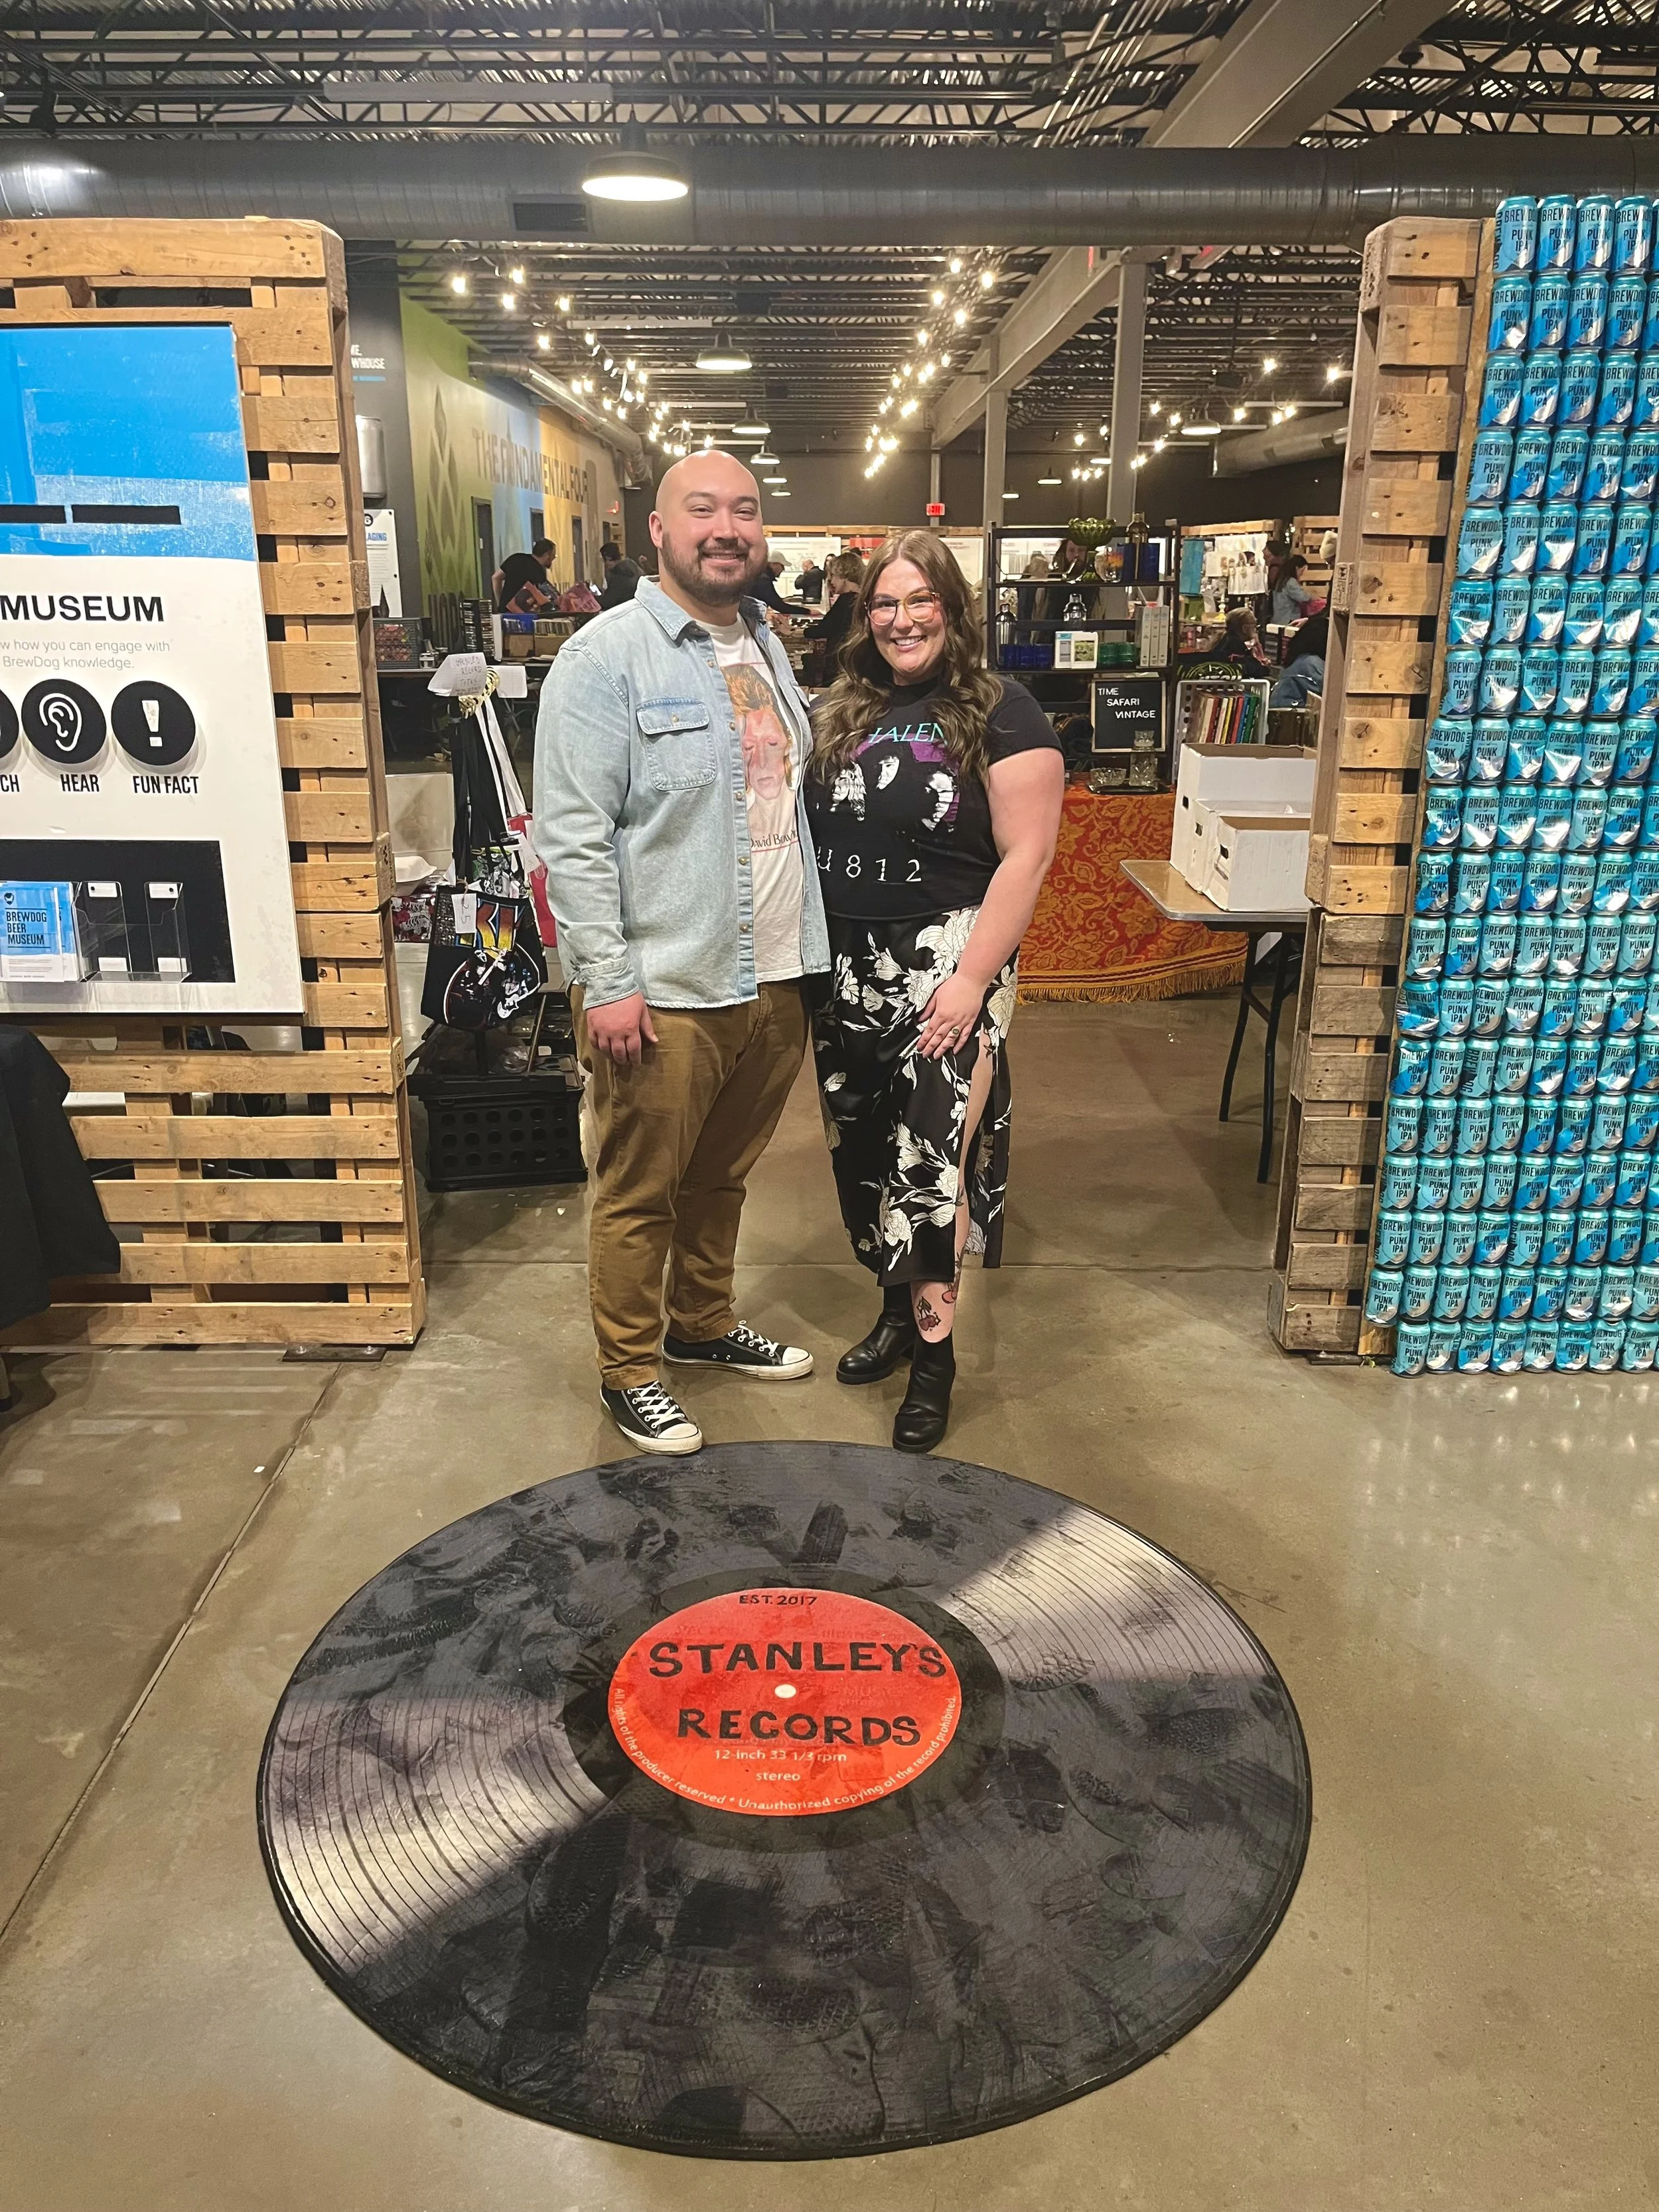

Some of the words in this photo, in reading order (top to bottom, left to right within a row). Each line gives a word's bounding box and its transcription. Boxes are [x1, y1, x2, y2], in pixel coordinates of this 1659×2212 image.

[1500, 309, 1523, 321] PUNK
[1542, 308, 1563, 319] PUNK
[1577, 308, 1599, 319] PUNK
[1616, 309, 1638, 320] PUNK
[1546, 319, 1558, 330] IPA
[1580, 318, 1593, 329] IPA
[1619, 321, 1632, 332] IPA
[1493, 388, 1515, 398] PUNK
[1568, 386, 1590, 396] PUNK
[1484, 463, 1505, 473] PUNK
[1632, 464, 1654, 474] PUNK
[1486, 473, 1499, 483] IPA
[1470, 538, 1492, 548] PUNK
[0, 595, 165, 622] MUSEUM
[1503, 609, 1522, 618] PUNK
[14, 639, 40, 650] how
[44, 641, 66, 653] you
[69, 641, 92, 651] can
[95, 641, 142, 654] engage
[145, 640, 170, 652] with
[3, 656, 60, 670] BrewDog
[64, 657, 135, 670] knowledge.
[1532, 677, 1552, 686] PUNK
[1115, 710, 1156, 719] VINTAGE
[1430, 729, 1465, 742] BREWDOG
[1435, 747, 1455, 757] PUNK
[1477, 747, 1497, 757] PUNK
[1589, 751, 1610, 761] PUNK
[1628, 756, 1640, 767] IPA
[60, 774, 100, 792] HEAR
[133, 776, 161, 794] FUN
[164, 776, 199, 794] FACT
[1474, 814, 1496, 822] PUNK
[1617, 814, 1637, 824] PUNK
[1496, 878, 1517, 888] PUNK
[1568, 881, 1589, 890] PUNK
[1470, 889, 1481, 898] IPA
[1570, 891, 1582, 899] IPA
[6, 911, 47, 922] BREWDOG
[7, 922, 27, 933] BEER
[8, 934, 44, 944] MUSEUM
[1412, 929, 1444, 940] BREWDOG
[1415, 944, 1434, 953] PUNK
[1457, 944, 1477, 952] PUNK
[1489, 940, 1510, 950] PUNK
[1530, 941, 1550, 950] PUNK
[1554, 943, 1574, 952] PUNK
[1597, 942, 1617, 950] PUNK
[1630, 940, 1650, 949] PUNK
[1419, 953, 1429, 962] IPA
[1493, 950, 1505, 959] IPA
[1600, 950, 1611, 960] IPA
[1633, 949, 1645, 958] IPA
[1448, 1005, 1468, 1014] PUNK
[1475, 1004, 1495, 1015] PUNK
[1513, 1001, 1534, 1011] PUNK
[1552, 1005, 1572, 1013] PUNK
[1578, 1003, 1597, 1012] PUNK
[1620, 1001, 1639, 1010] PUNK
[1451, 1013, 1463, 1023] IPA
[1478, 1014, 1490, 1023] IPA
[1555, 1013, 1567, 1023] IPA
[1581, 1011, 1593, 1021] IPA
[1440, 1066, 1459, 1074] PUNK
[1506, 1062, 1524, 1071] PUNK
[1575, 1066, 1595, 1074] PUNK
[1443, 1074, 1454, 1083] IPA
[1508, 1070, 1520, 1080] IPA
[1502, 1122, 1520, 1131] PUNK
[1603, 1120, 1622, 1128] PUNK
[1636, 1117, 1653, 1126] PUNK
[1398, 1122, 1416, 1132] PUNK
[1469, 1124, 1487, 1134] PUNK
[1639, 1126, 1649, 1135] IPA
[1401, 1132, 1412, 1140] IPA
[1473, 1133, 1483, 1142] IPA
[1506, 1130, 1515, 1138] IPA
[1606, 1128, 1616, 1137] IPA
[1429, 1180, 1449, 1189] PUNK
[1494, 1178, 1513, 1187] PUNK
[1527, 1181, 1545, 1190] PUNK
[1397, 1189, 1407, 1198] IPA
[1463, 1189, 1474, 1198] IPA
[1498, 1187, 1509, 1196] IPA
[1560, 1187, 1571, 1197] IPA
[1390, 1236, 1407, 1244] PUNK
[1418, 1236, 1435, 1244] PUNK
[1587, 1234, 1606, 1242] PUNK
[1393, 1244, 1404, 1253] IPA
[1421, 1244, 1432, 1253] IPA
[1456, 1244, 1466, 1253] IPA
[1590, 1242, 1601, 1250] IPA
[1370, 1279, 1400, 1292] BREWDOG
[1407, 1290, 1426, 1299] PUNK
[1445, 1290, 1462, 1299] PUNK
[1569, 1290, 1587, 1298] PUNK
[1374, 1294, 1394, 1305] PUNK
[1409, 1298, 1421, 1307] IPA
[1448, 1299, 1459, 1308] IPA
[1481, 1298, 1492, 1307] IPA
[1532, 1341, 1551, 1351] PUNK
[1596, 1342, 1615, 1351] PUNK
[1405, 1347, 1423, 1356] PUNK
[1407, 1355, 1419, 1364] IPA
[738, 1594, 772, 1605] EST.
[777, 1595, 818, 1605] 2017
[614, 1688, 625, 1700] All
[613, 1700, 626, 1726] rights
[936, 1695, 958, 1742] prohibited.
[619, 1726, 632, 1737] of
[677, 1708, 921, 1746] RECORDS
[624, 1735, 638, 1751] the
[715, 1749, 766, 1760] 12-inch
[770, 1749, 787, 1760] 33
[792, 1751, 815, 1761] 1/3
[817, 1752, 847, 1763] rpm
[912, 1739, 941, 1769] record
[632, 1750, 674, 1784] producer
[896, 1763, 916, 1780] the
[756, 1771, 801, 1781] stereo
[883, 1776, 897, 1789] of
[674, 1780, 727, 1805] reserved
[833, 1784, 885, 1806] copying
[737, 1797, 831, 1810] Unauthorized
